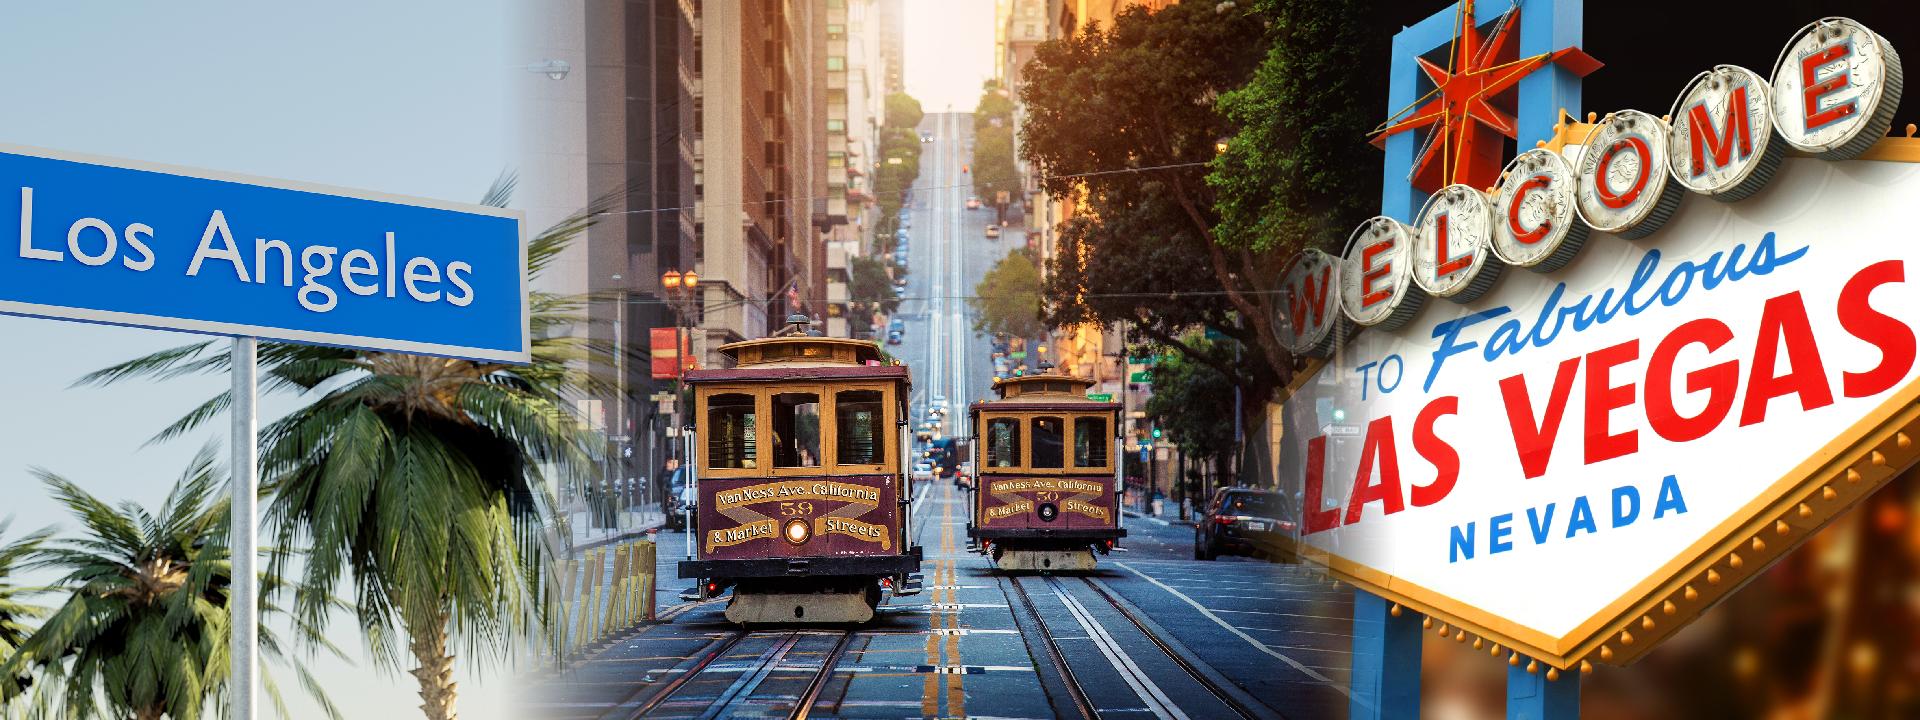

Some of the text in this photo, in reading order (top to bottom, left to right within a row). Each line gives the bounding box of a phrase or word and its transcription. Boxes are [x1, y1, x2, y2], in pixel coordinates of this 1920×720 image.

[1288, 40, 1857, 337] WELCOME
[19, 187, 475, 313] Los Angeles
[1356, 231, 1810, 402] TO Fabulous
[1301, 259, 1917, 537] LAS VEGAS
[812, 483, 878, 501] California
[1058, 480, 1103, 492] California
[998, 502, 1031, 516] Market
[1067, 501, 1104, 516] Streets
[1449, 474, 1688, 563] NEVADA
[713, 523, 773, 543] & Market
[826, 519, 881, 538] Streets
